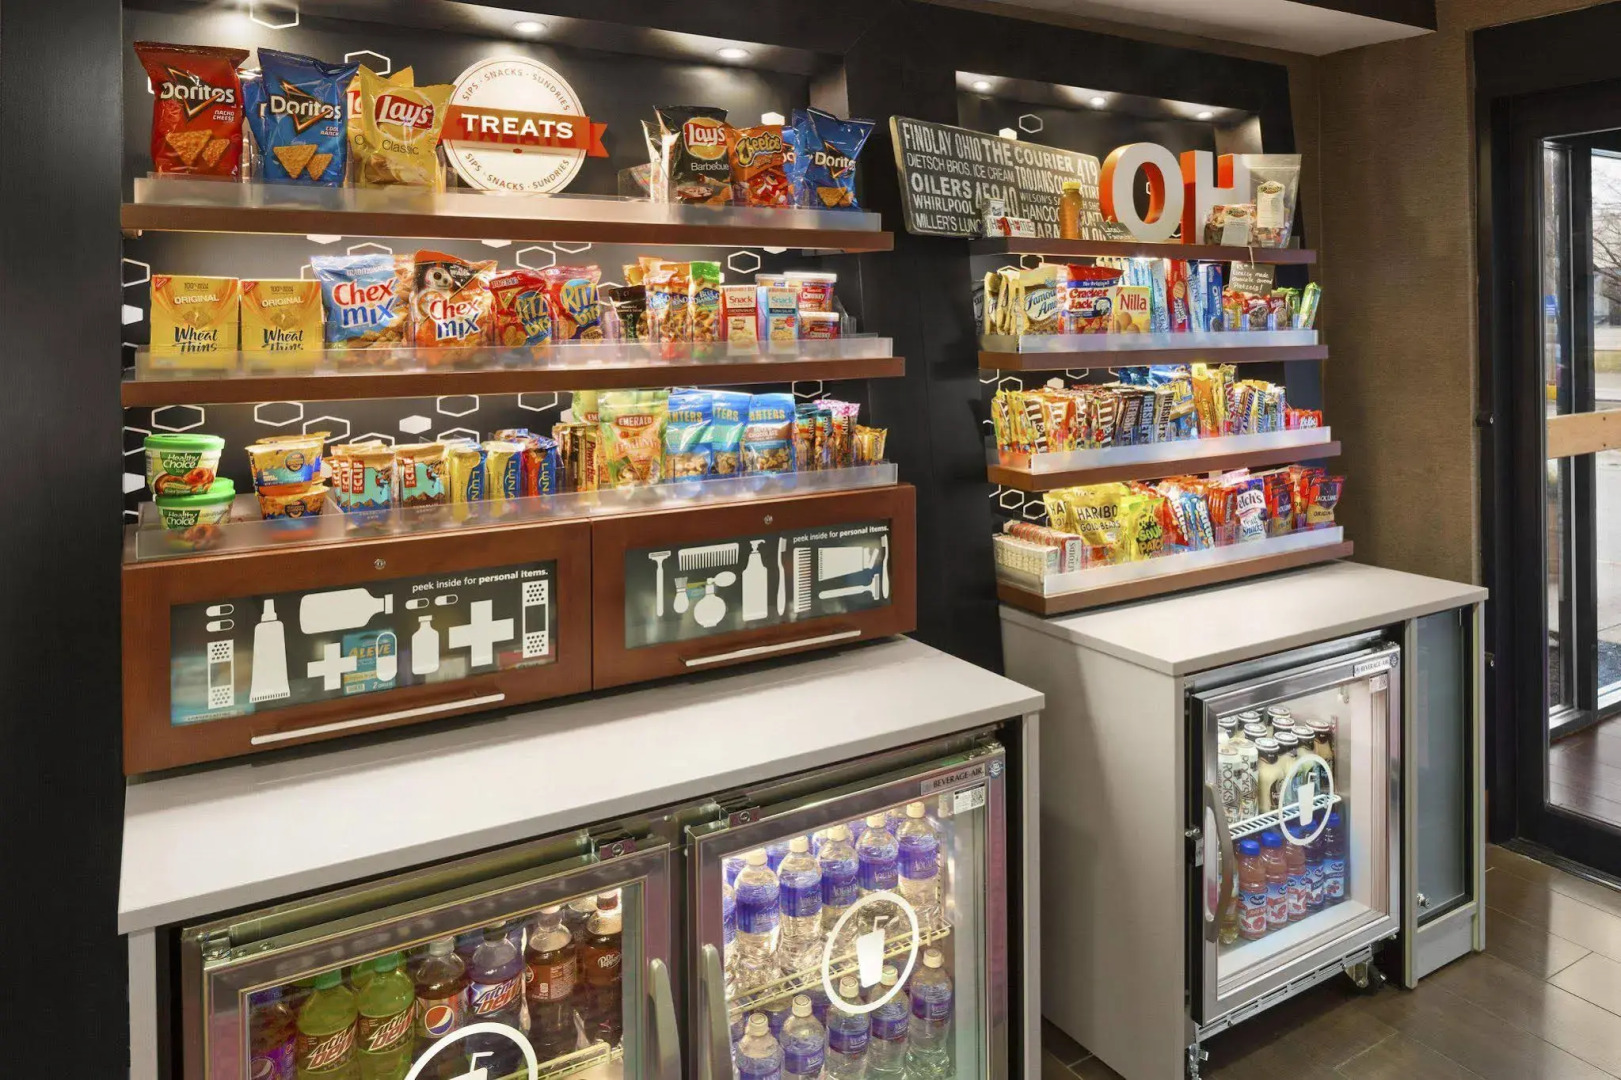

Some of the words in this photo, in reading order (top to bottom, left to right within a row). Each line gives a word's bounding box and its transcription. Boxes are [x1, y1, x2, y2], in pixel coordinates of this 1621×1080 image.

[160, 82, 235, 104] Doritos
[462, 82, 479, 101] SIPS
[484, 68, 523, 82] SNACKS
[532, 73, 570, 111] SUNDRIES
[271, 95, 342, 121] Doritos
[377, 95, 434, 128] Lay's
[461, 113, 573, 139] TREATS
[381, 139, 420, 156] Classic
[735, 132, 782, 166] Cheetos
[902, 122, 953, 157] FINDLAY
[955, 132, 982, 162] OHIO
[981, 138, 1013, 167] THE
[1014, 146, 1075, 173] COURIER
[1077, 158, 1099, 185] 419
[465, 152, 482, 173] SIPS
[487, 174, 524, 191] SNACKS
[532, 159, 570, 190] SUNDRIES
[691, 162, 729, 172] Barbecue
[906, 152, 945, 172] DIETSCH
[946, 159, 972, 176] BROS.
[973, 164, 987, 179] ICE
[987, 166, 1015, 183] CREAM
[911, 172, 973, 200] OILERS
[1015, 165, 1055, 193] TROJANS
[912, 193, 976, 215] WHIRLPOOL
[1022, 203, 1060, 222] HANCO
[915, 212, 958, 232] MILLER'S
[174, 294, 220, 305] ORIGINAL
[333, 278, 395, 306] Chex
[729, 295, 753, 304] Snack
[772, 295, 793, 304] Snack
[1069, 287, 1110, 300] Cracker
[262, 296, 303, 308] ORIGINAL
[430, 299, 479, 321] Chex
[1035, 300, 1057, 319] Amo
[1068, 299, 1094, 311] Jack
[1119, 294, 1147, 312] Nilla
[343, 297, 395, 327] mix
[174, 325, 218, 343] Wheat
[263, 326, 304, 344] Wheat
[437, 313, 479, 339] mix
[172, 342, 218, 355] Thins
[1225, 383, 1236, 421] TWIX
[619, 416, 653, 427] EMERALD
[668, 411, 704, 423] ANTERS
[717, 407, 740, 421] TERS
[750, 408, 786, 421] ANTERS
[1142, 395, 1154, 444] HERSHEY'S
[1158, 395, 1174, 438] HERSHEY'S
[808, 418, 816, 439] KIND
[841, 416, 849, 435] KIND
[163, 456, 197, 469] Choice
[167, 452, 199, 464] Healthy
[587, 440, 597, 483] PowerBar
[353, 462, 364, 487] CLIF
[404, 459, 416, 481] CLIF
[470, 470, 480, 500] LUN
[1238, 489, 1264, 509] elch's
[166, 515, 195, 526] Choice
[168, 510, 198, 520] Healthy
[1076, 504, 1118, 521] HARIBO
[793, 534, 809, 543] peek
[810, 531, 828, 541] inside
[829, 530, 839, 538] for
[839, 526, 868, 539] personal
[869, 525, 889, 533] items.
[1137, 526, 1163, 542] SOUR
[412, 580, 434, 593] peek
[436, 578, 462, 590] inside
[464, 576, 477, 586] for
[478, 571, 519, 586] personal
[521, 568, 549, 579] items.
[349, 643, 391, 659] ALEVE
